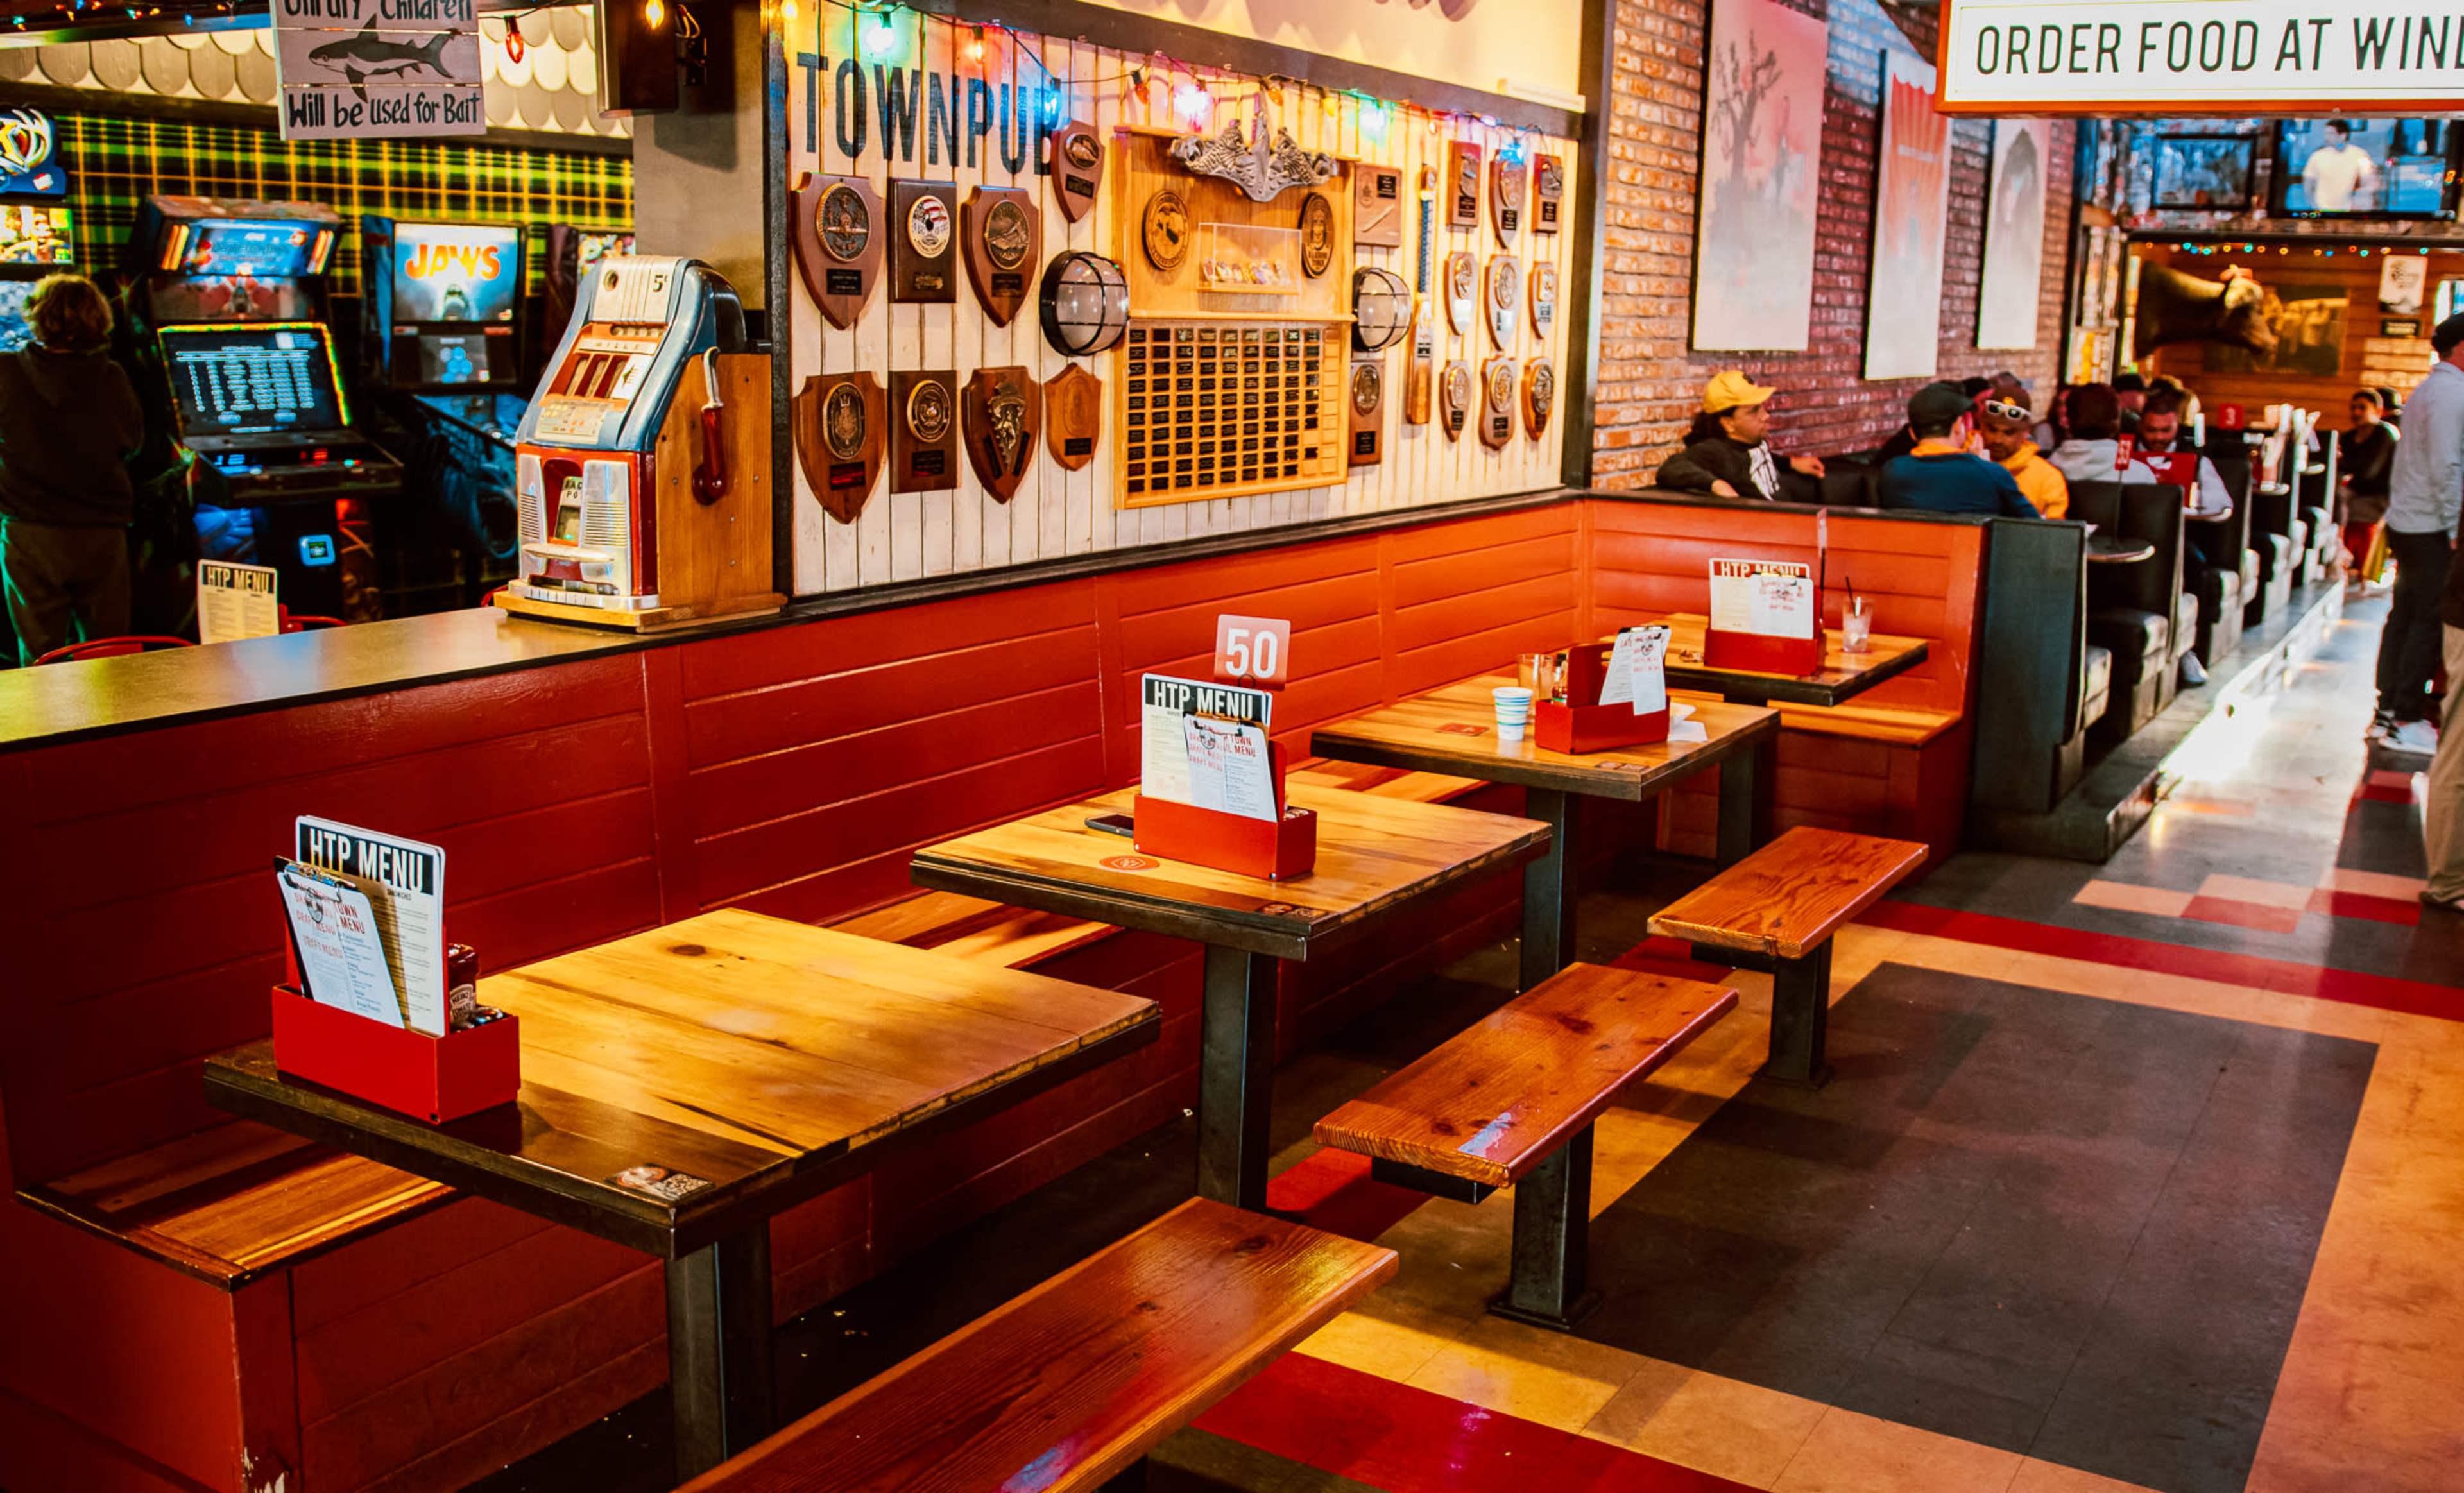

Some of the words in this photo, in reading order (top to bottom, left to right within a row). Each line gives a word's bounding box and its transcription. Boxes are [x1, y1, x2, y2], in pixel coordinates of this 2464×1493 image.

[1976, 23, 2122, 75] ORDER
[2137, 20, 2259, 73] FOOD
[2274, 17, 2332, 71] AT
[288, 93, 325, 128] Will
[334, 94, 363, 127] be
[370, 93, 411, 126] used
[413, 92, 440, 124] for
[443, 93, 481, 124] Bait
[405, 243, 501, 281] JAWS
[207, 565, 231, 588] HTP
[234, 568, 269, 593] MENU
[1720, 561, 1751, 578] HTP
[1226, 627, 1278, 678] 50
[1154, 681, 1190, 710] HTP
[1197, 687, 1253, 720] MENU
[309, 828, 351, 873] HTP
[358, 840, 424, 892] MENU
[339, 916, 366, 935] MENU
